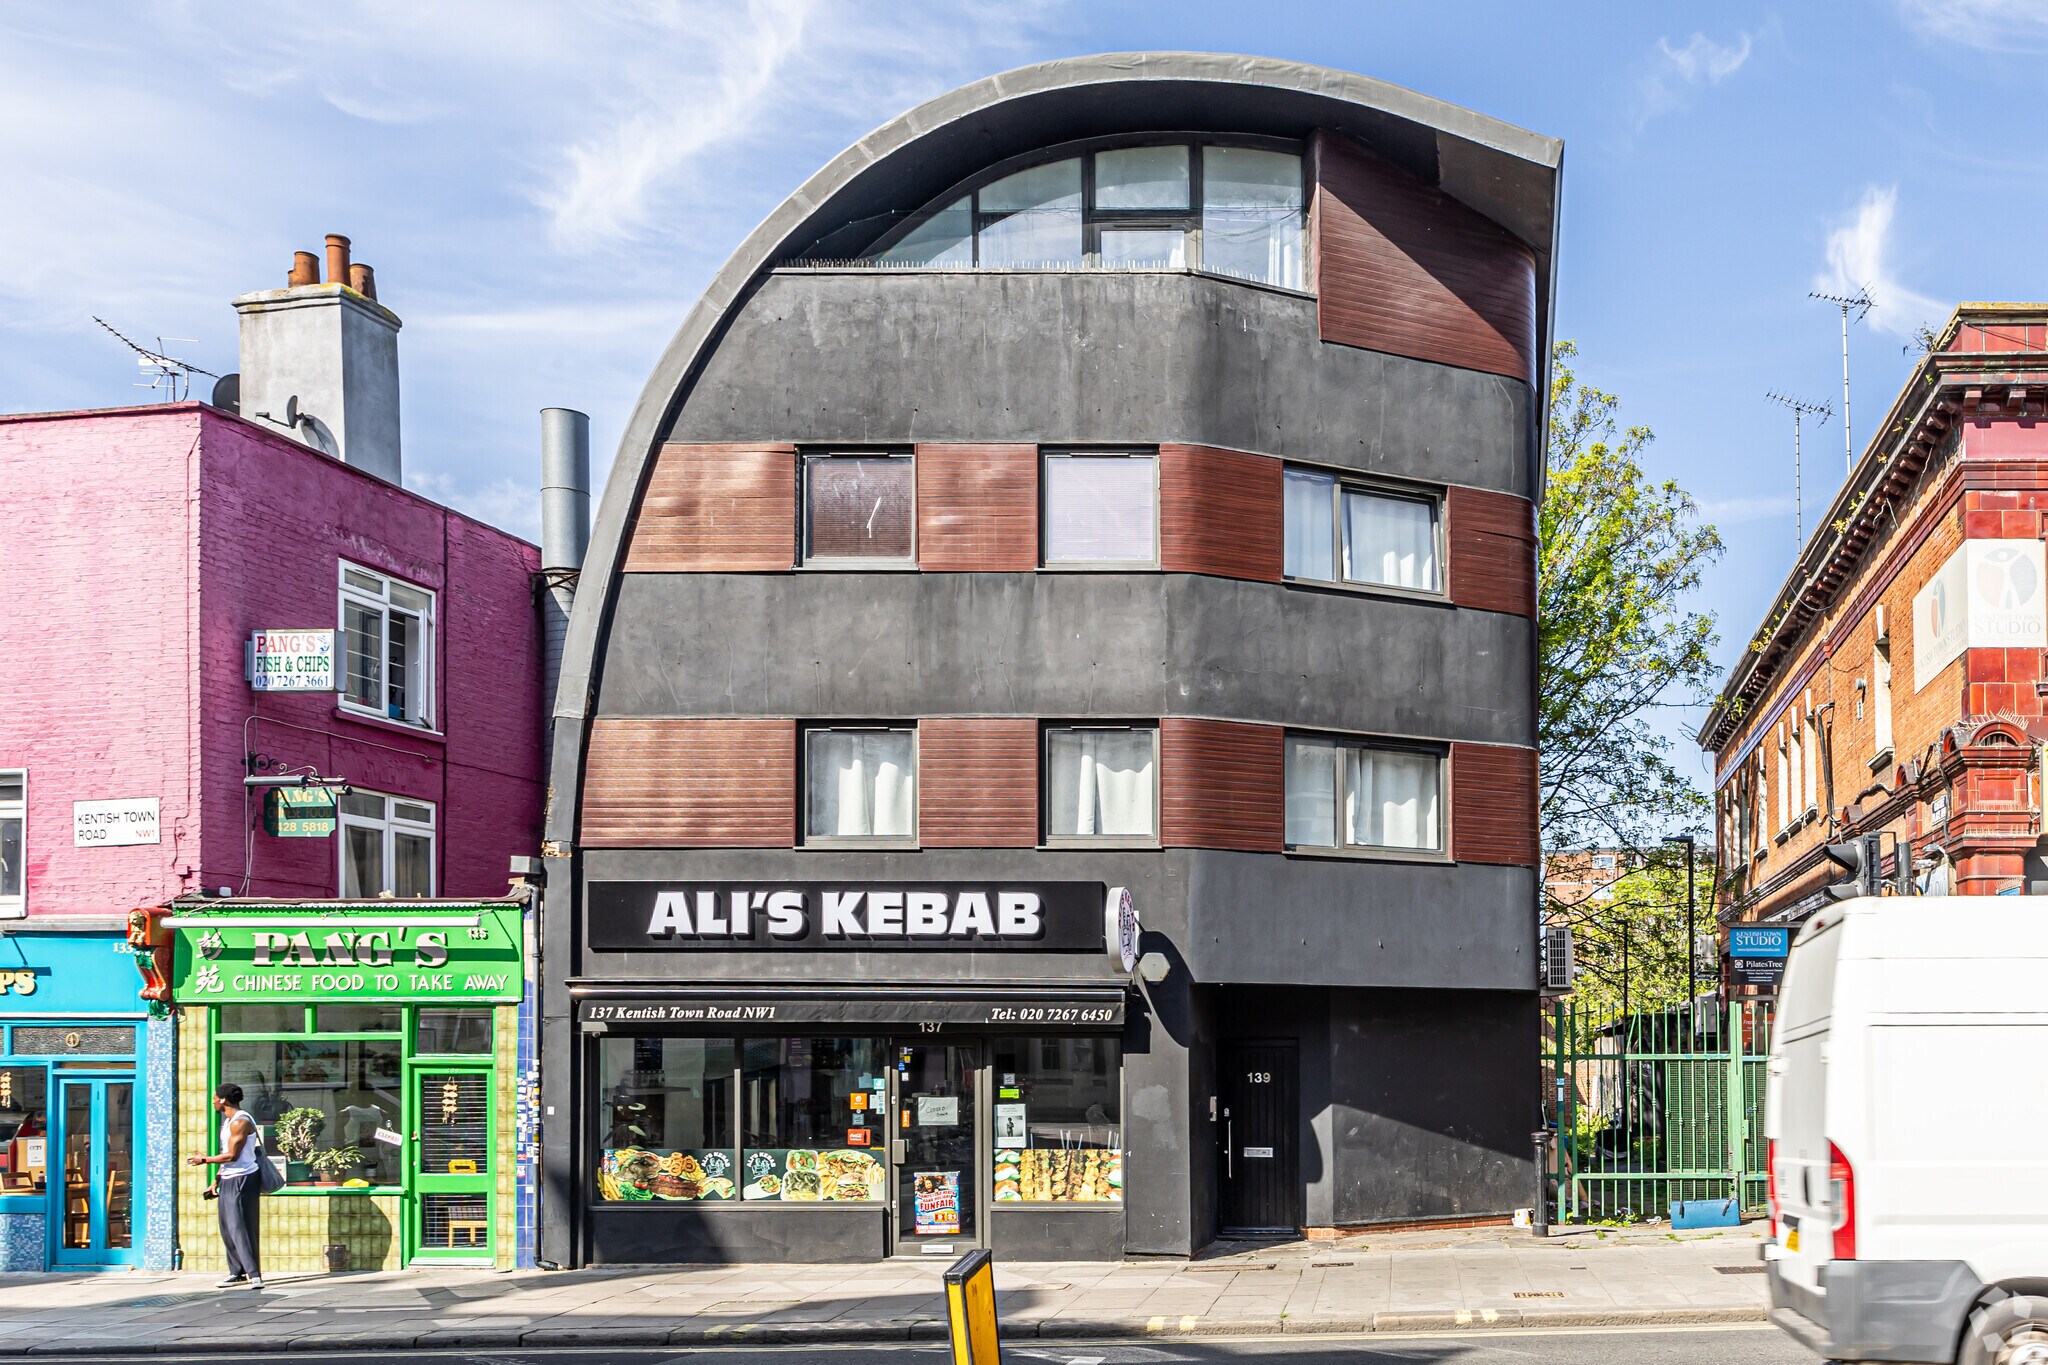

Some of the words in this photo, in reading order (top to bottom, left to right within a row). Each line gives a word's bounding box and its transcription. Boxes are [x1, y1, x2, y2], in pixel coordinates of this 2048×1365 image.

[1974, 621, 2041, 635] STUDIO
[256, 634, 316, 653] PANG'S
[256, 656, 281, 672] FISH
[285, 656, 293, 672] &
[296, 656, 330, 672] CHIPS
[256, 675, 274, 687] 020
[277, 675, 301, 687] 7267
[304, 675, 329, 687] 3661
[272, 788, 329, 803] PANG'S
[78, 812, 120, 825] KENTISH
[124, 810, 155, 823] TOWN
[305, 806, 332, 819] FOOD
[272, 821, 297, 832] 7428
[302, 821, 329, 832] 5818
[78, 828, 107, 841] ROAD
[135, 829, 156, 838] NW1
[645, 890, 805, 937] ALI'S
[821, 890, 1043, 937] KEBAB
[251, 926, 449, 968] PANG'S
[466, 927, 489, 940] 135
[1736, 936, 1782, 946] STUDIO
[1746, 960, 1783, 968] PilatesTree
[232, 974, 302, 993] CHINESE
[312, 974, 366, 992] FOOD
[374, 974, 400, 992] TO
[409, 974, 454, 992] TAKE
[464, 974, 509, 992] AWAY
[589, 1006, 612, 1019] 137
[615, 1006, 666, 1019] Kentish
[669, 1006, 704, 1019] Town
[707, 1006, 741, 1019] Road
[742, 1006, 776, 1019] NW1
[991, 1007, 1017, 1020] Tel:
[1019, 1008, 1043, 1020] 020
[1047, 1008, 1078, 1021] 7267
[1081, 1009, 1113, 1021] 6450
[918, 1022, 943, 1033] 137
[1246, 1072, 1271, 1083] 139
[920, 1199, 955, 1211] FUNFAIR
